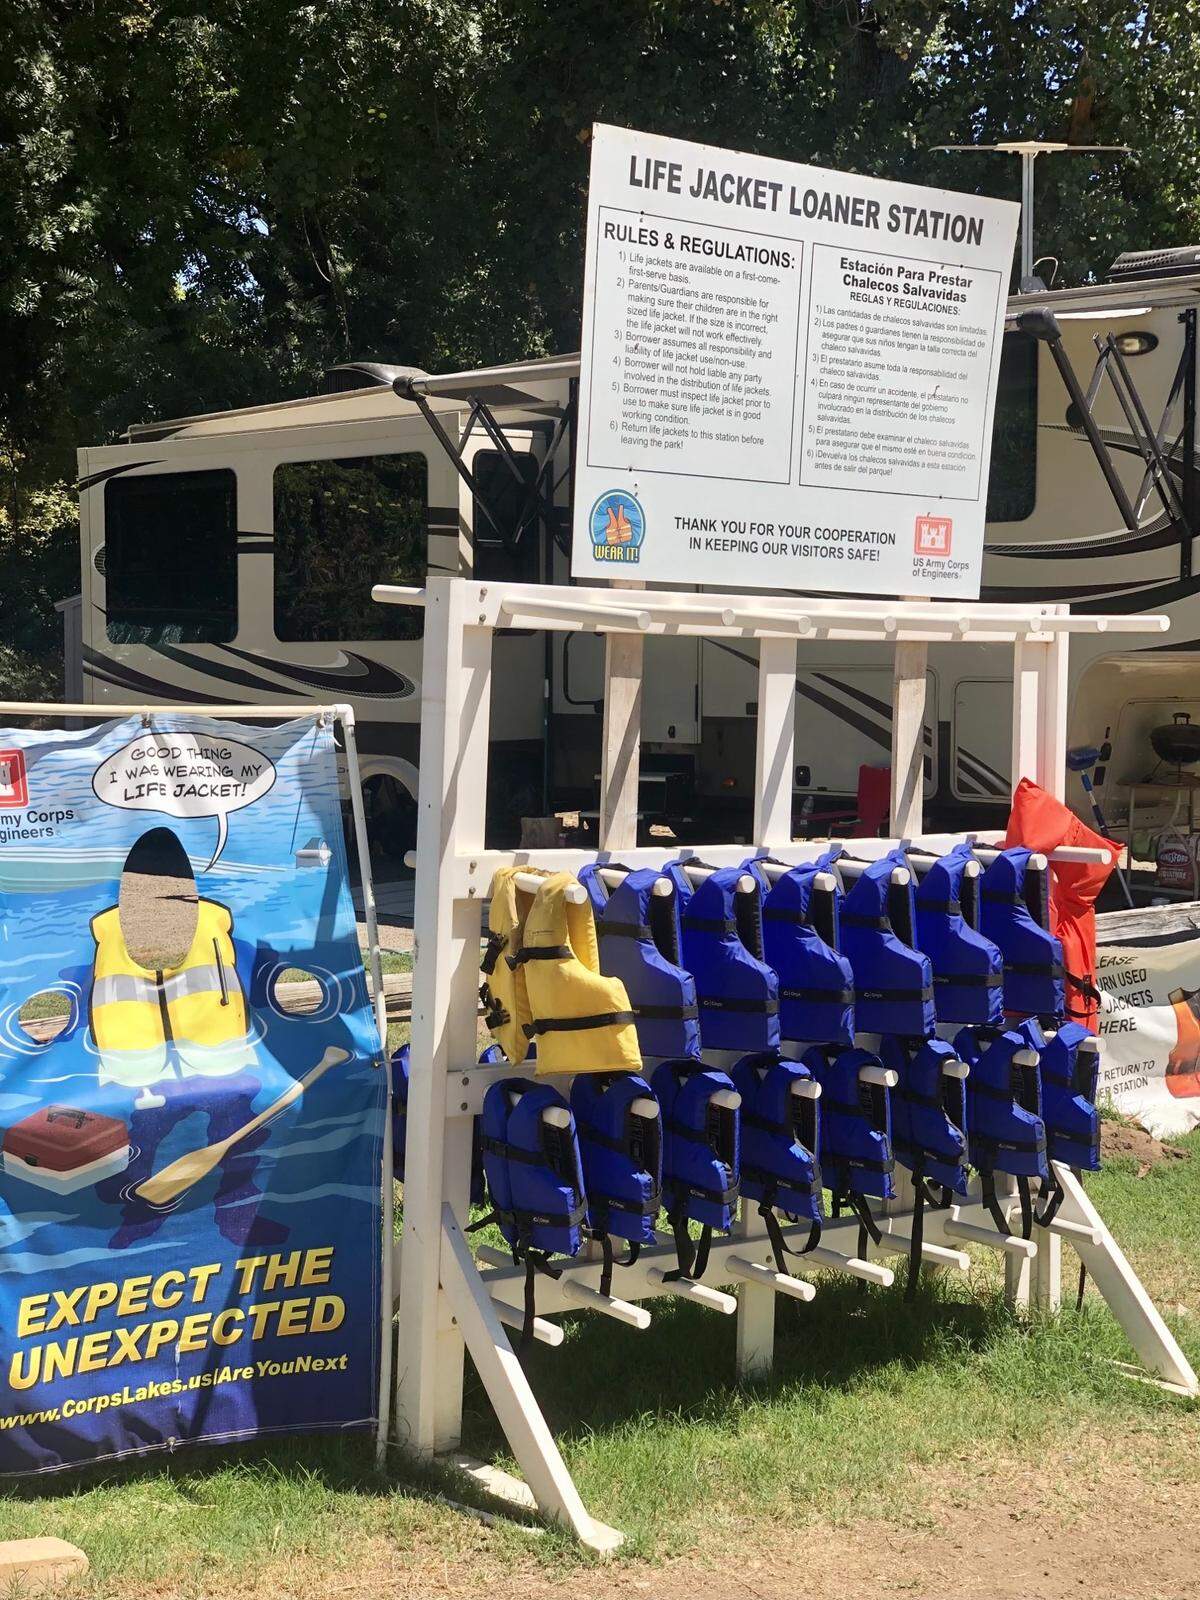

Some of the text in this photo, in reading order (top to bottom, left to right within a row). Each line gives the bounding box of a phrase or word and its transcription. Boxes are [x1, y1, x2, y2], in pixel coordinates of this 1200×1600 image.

[629, 155, 984, 246] LIFE JACKET LOANER STATION
[604, 222, 795, 269] RULES & REGULATIONS:
[619, 250, 781, 285] 1) Life jackets are available on a first-come-
[628, 265, 691, 284] first-serve basis.
[840, 257, 973, 288] Estación Para Prestar
[616, 277, 769, 309] 2) Parents/Guardians are responsible for
[843, 273, 966, 303] Chalecos Salvavidas
[627, 293, 656, 307] making
[657, 298, 674, 307] sure
[676, 299, 693, 310] their
[694, 302, 724, 315] children
[726, 308, 738, 317] are
[748, 310, 760, 320] the
[762, 313, 778, 324] right
[850, 291, 960, 315] REGLAS Y REGULACIONES:
[626, 318, 639, 329] the
[640, 320, 652, 331] life
[653, 323, 677, 334] jacket
[678, 326, 690, 335] will
[692, 329, 704, 338] not
[706, 331, 724, 340] work
[614, 329, 772, 359] 3) Borrower assumes all responsibility and
[612, 356, 762, 385] 4) Borrower will not hold liable any party
[624, 370, 656, 383] involved
[666, 375, 678, 385] the
[680, 377, 721, 390] distribution
[722, 382, 730, 391] of
[731, 383, 743, 393] life
[621, 410, 652, 423] working
[609, 420, 764, 445] 6) Return life jackets to this station before
[620, 435, 683, 449] leaving the park!
[674, 516, 896, 545] THANK YOU FOR YOUR COOPERATION
[592, 544, 640, 562] WEAR IT!
[689, 537, 880, 562] IN KEEPING OUR VISITORS SAFE!
[912, 567, 959, 580] of Engineers
[913, 557, 969, 571] US Army Corps
[131, 746, 232, 761] GOOD THING
[110, 764, 262, 784] I WAS WEARING MY
[124, 782, 247, 801] LIFE JACKET!
[26, 809, 74, 824] Corps
[1118, 968, 1147, 987] USED
[1106, 989, 1154, 1015] JACKETS
[1098, 1017, 1137, 1035] HERE
[1104, 1062, 1140, 1082] RETURN
[1143, 1059, 1155, 1071] TO
[1113, 1075, 1149, 1095] STATION
[16, 1246, 335, 1339] EXPECT THE
[8, 1295, 347, 1391] UNEXPECTED
